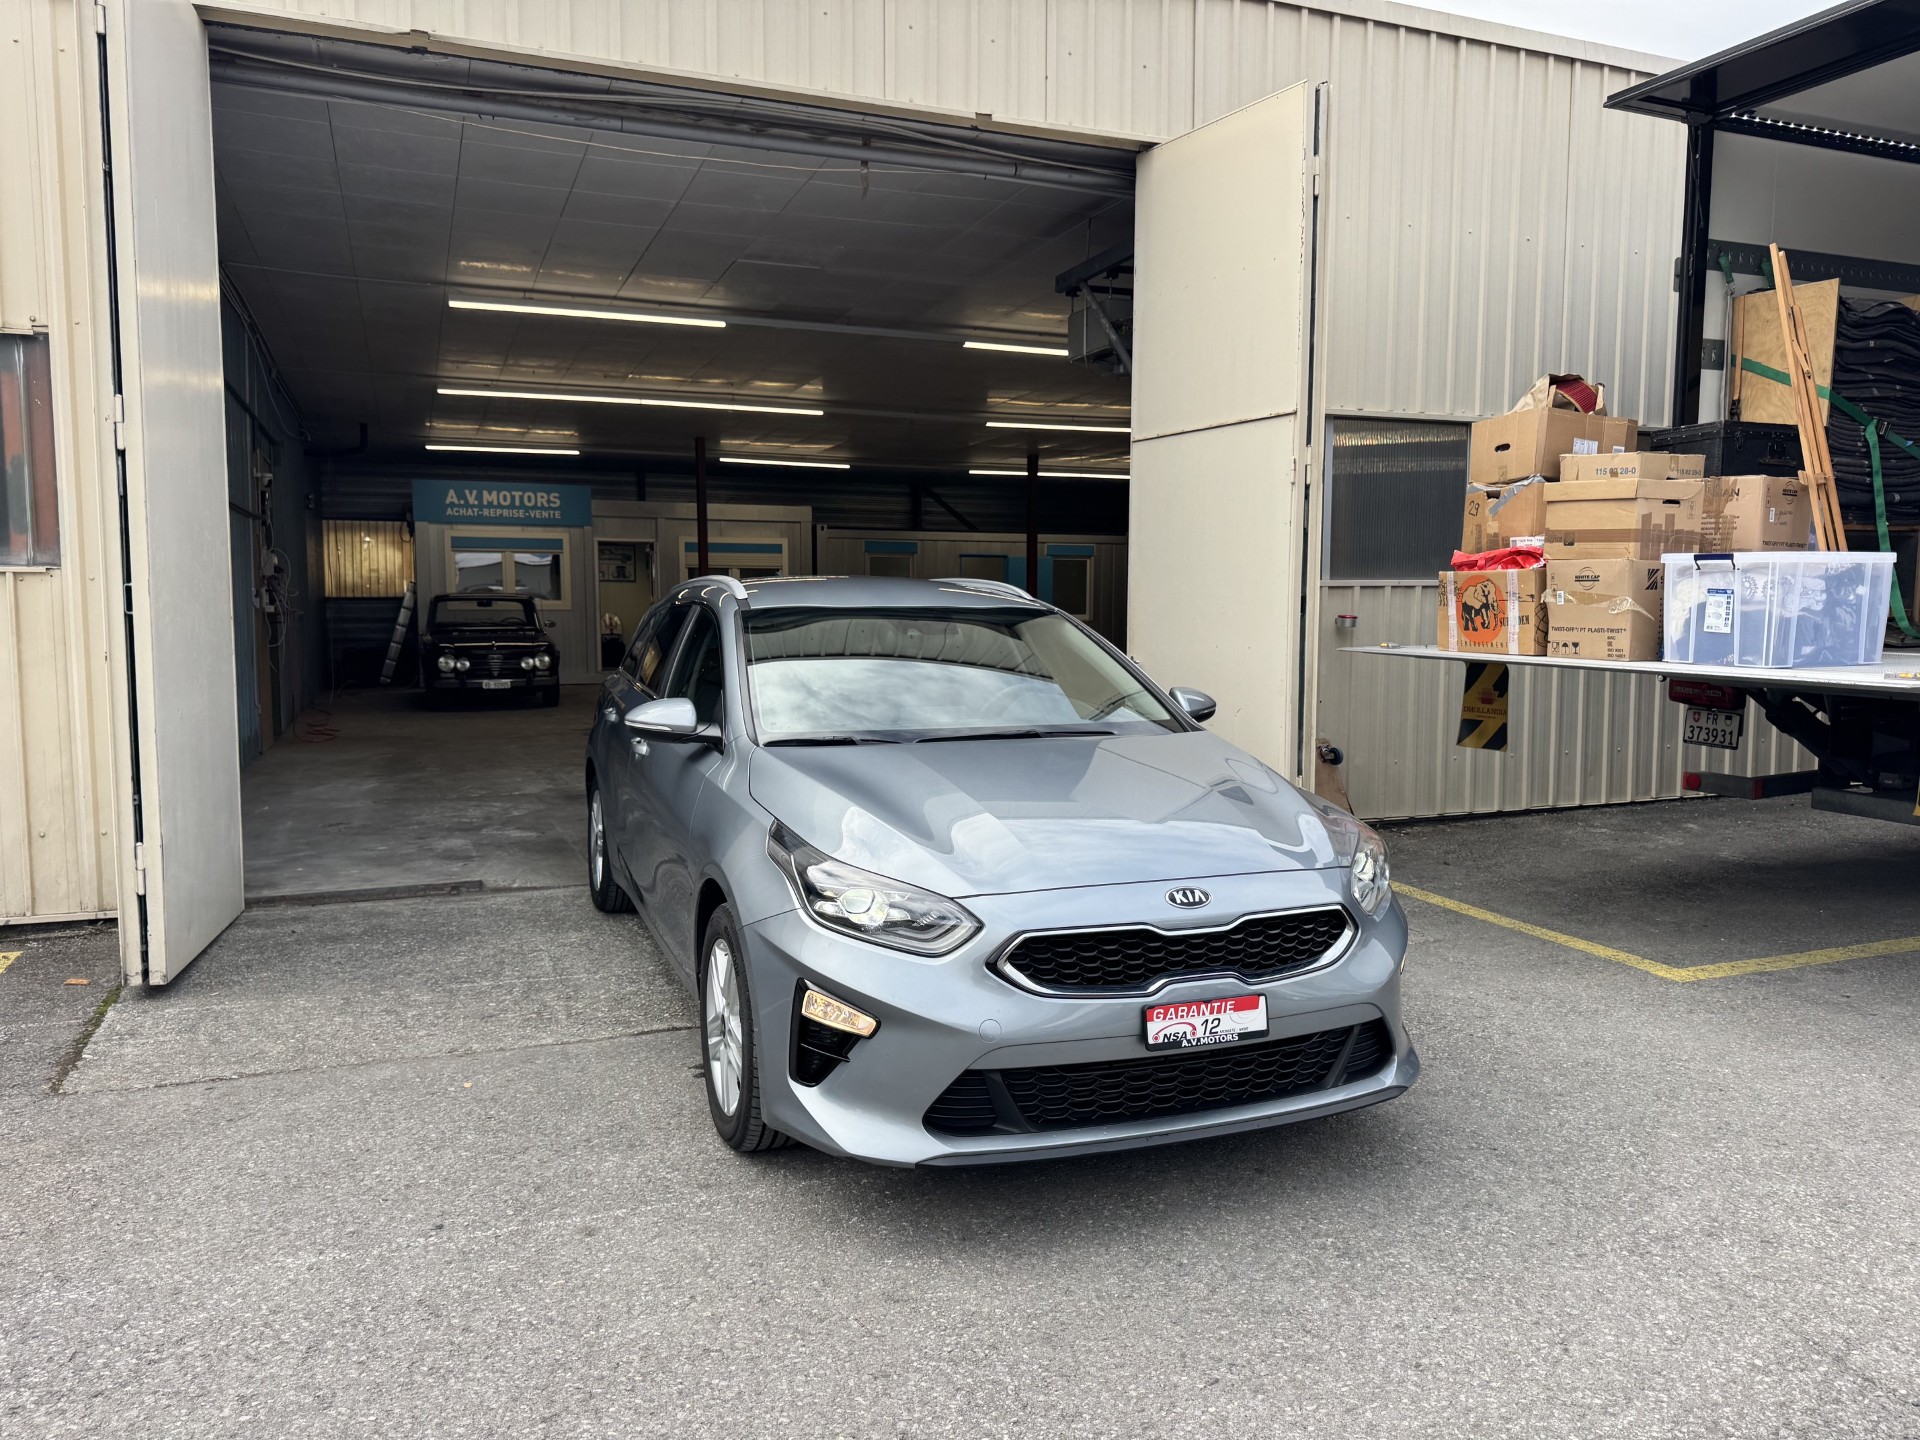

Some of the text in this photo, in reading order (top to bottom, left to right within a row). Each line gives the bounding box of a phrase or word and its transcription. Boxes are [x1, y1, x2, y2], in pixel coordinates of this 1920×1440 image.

[1595, 467, 1607, 476] 115
[1620, 466, 1636, 475] 28-0
[445, 488, 561, 507] A.V. MOTORS
[446, 507, 561, 519] ACHAT-REPRISE-VENTE
[1468, 500, 1480, 517] 29
[1463, 705, 1507, 716] DHOLLANDIA
[1706, 712, 1719, 725] FR
[1687, 725, 1734, 745] 373931
[1172, 889, 1207, 904] KIA
[1153, 1001, 1236, 1021] GARANTIE
[1200, 1017, 1221, 1036] 12
[1162, 1031, 1188, 1042] NSA
